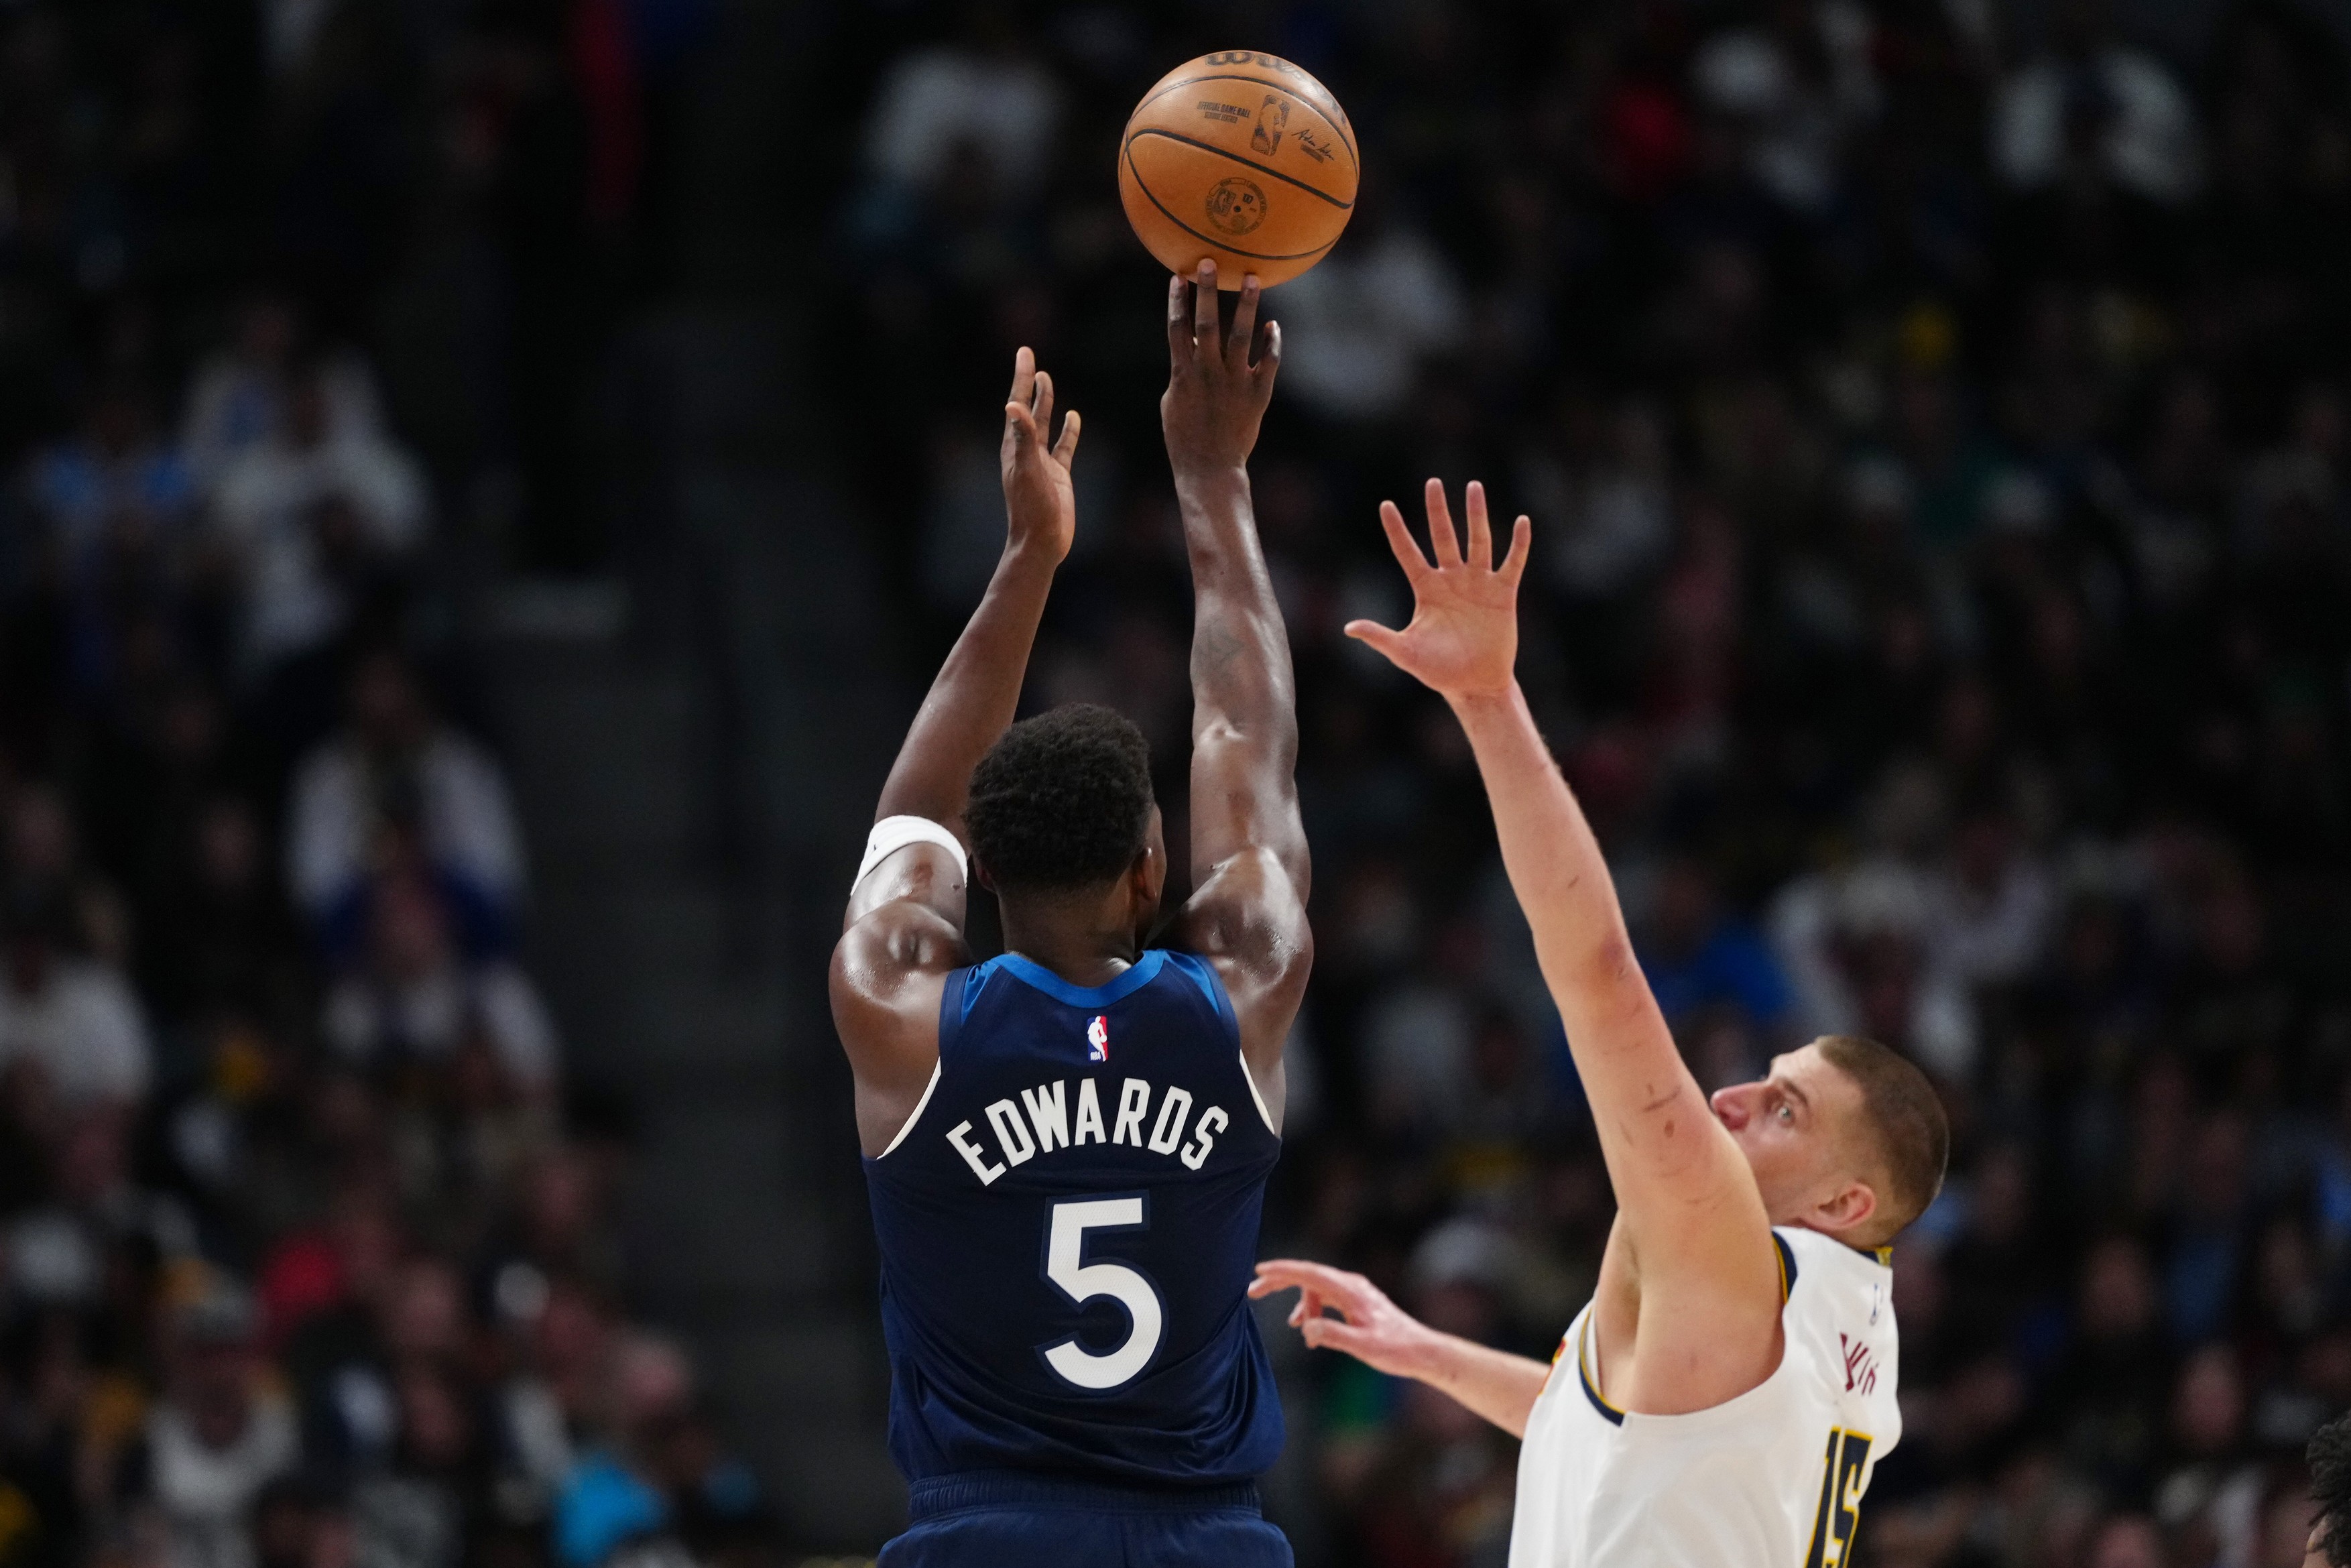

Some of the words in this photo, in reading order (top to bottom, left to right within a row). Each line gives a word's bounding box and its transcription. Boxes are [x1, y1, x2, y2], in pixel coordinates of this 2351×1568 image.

[1090, 1051, 1101, 1061] NBA
[945, 1077, 1229, 1186] EDWARDS
[1043, 1196, 1163, 1390] 5
[1803, 1425, 1874, 1567] 15
